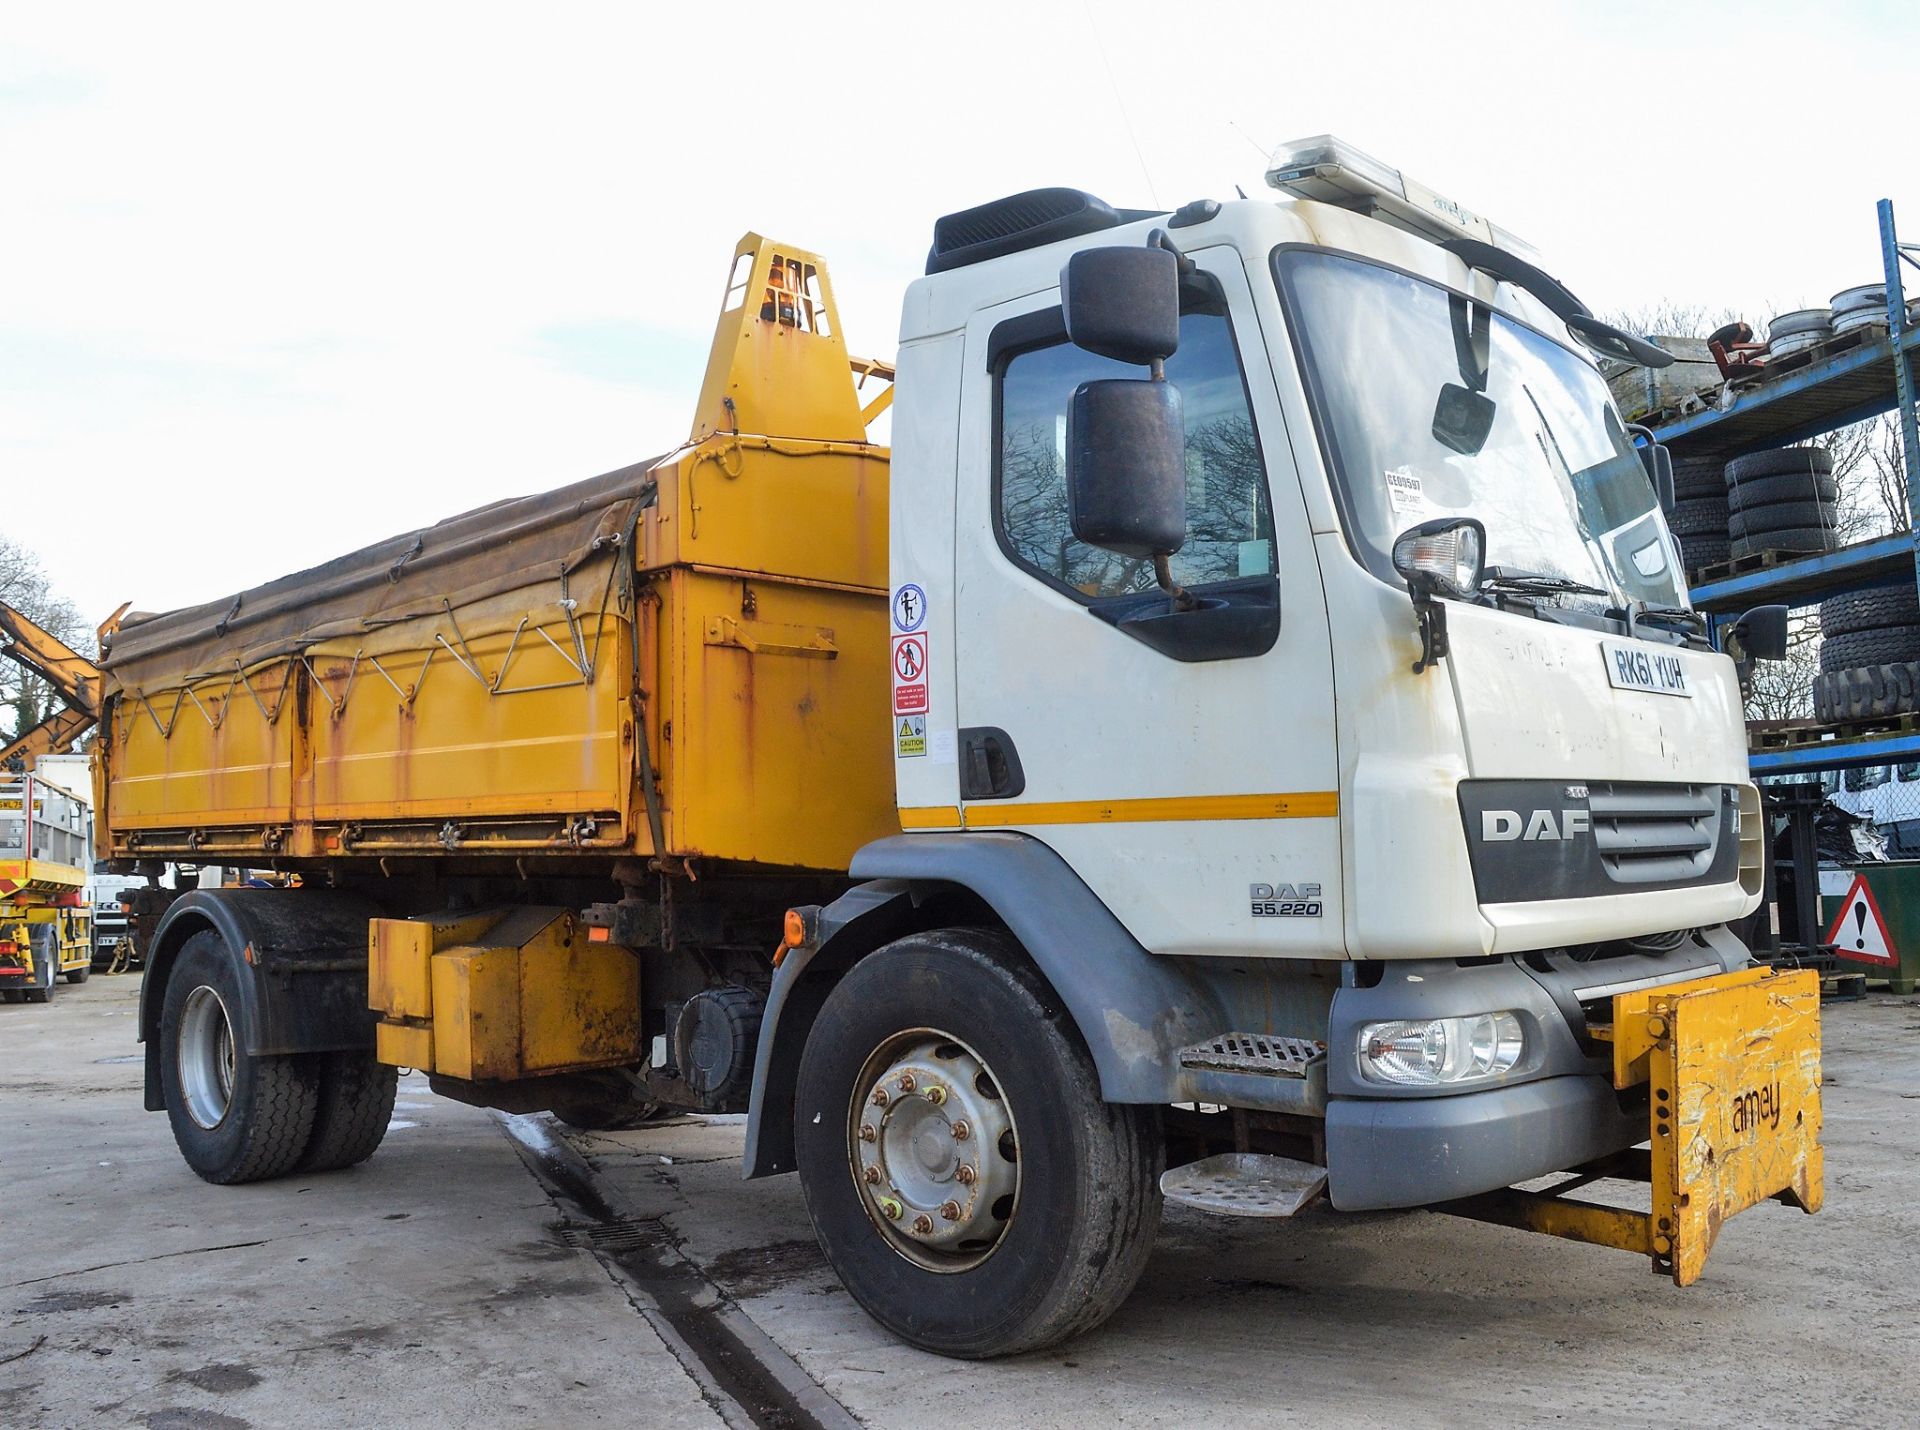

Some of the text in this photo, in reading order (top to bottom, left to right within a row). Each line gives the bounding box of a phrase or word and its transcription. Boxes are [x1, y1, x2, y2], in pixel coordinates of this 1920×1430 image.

[1615, 650, 1685, 690] RK61 YUH
[1481, 809, 1589, 842] DAF
[1250, 883, 1321, 899] DAF
[1251, 903, 1319, 915] 55.220
[1733, 1081, 1780, 1133] amey
